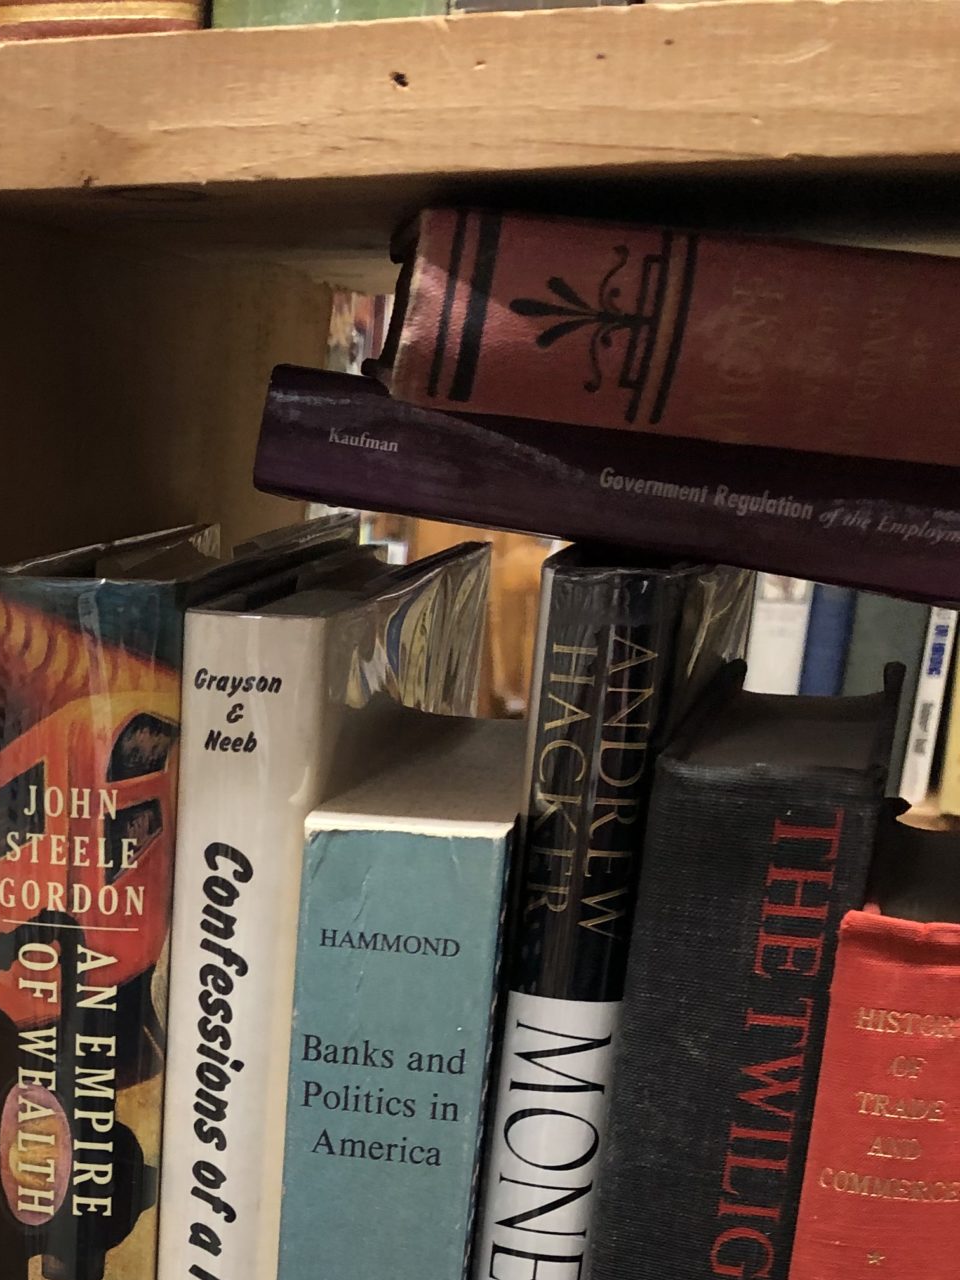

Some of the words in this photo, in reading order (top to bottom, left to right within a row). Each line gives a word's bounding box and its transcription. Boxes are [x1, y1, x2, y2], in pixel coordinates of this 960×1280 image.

[329, 426, 398, 454] Kaufman
[599, 466, 708, 505] Government
[713, 484, 814, 521] Regulation
[819, 509, 841, 529] of
[842, 510, 870, 531] the
[194, 667, 282, 695] Grayson
[226, 703, 244, 725] &
[204, 729, 257, 754] Neeb
[529, 640, 597, 914] HACKER
[577, 632, 661, 941] ANDREW
[24, 784, 118, 819] JOHN
[6, 831, 139, 870] STEELE
[752, 809, 842, 982] THE
[319, 928, 461, 958] HAMMOND
[17, 941, 60, 1003] OF
[73, 943, 119, 1013] AN
[194, 840, 254, 1151] Confessions
[855, 1006, 960, 1039] HISTOR
[300, 1033, 395, 1069] Banks
[407, 1048, 466, 1075] and
[891, 1054, 929, 1080] OF
[300, 1079, 417, 1119] Politics
[429, 1092, 459, 1122] in
[855, 1090, 947, 1123] TRADE
[16, 1027, 60, 1218] WEALTH
[70, 1031, 117, 1218] EMPIRE
[310, 1127, 443, 1167] America
[866, 1136, 922, 1161] AND
[192, 1160, 239, 1223] of
[189, 1225, 224, 1257] a
